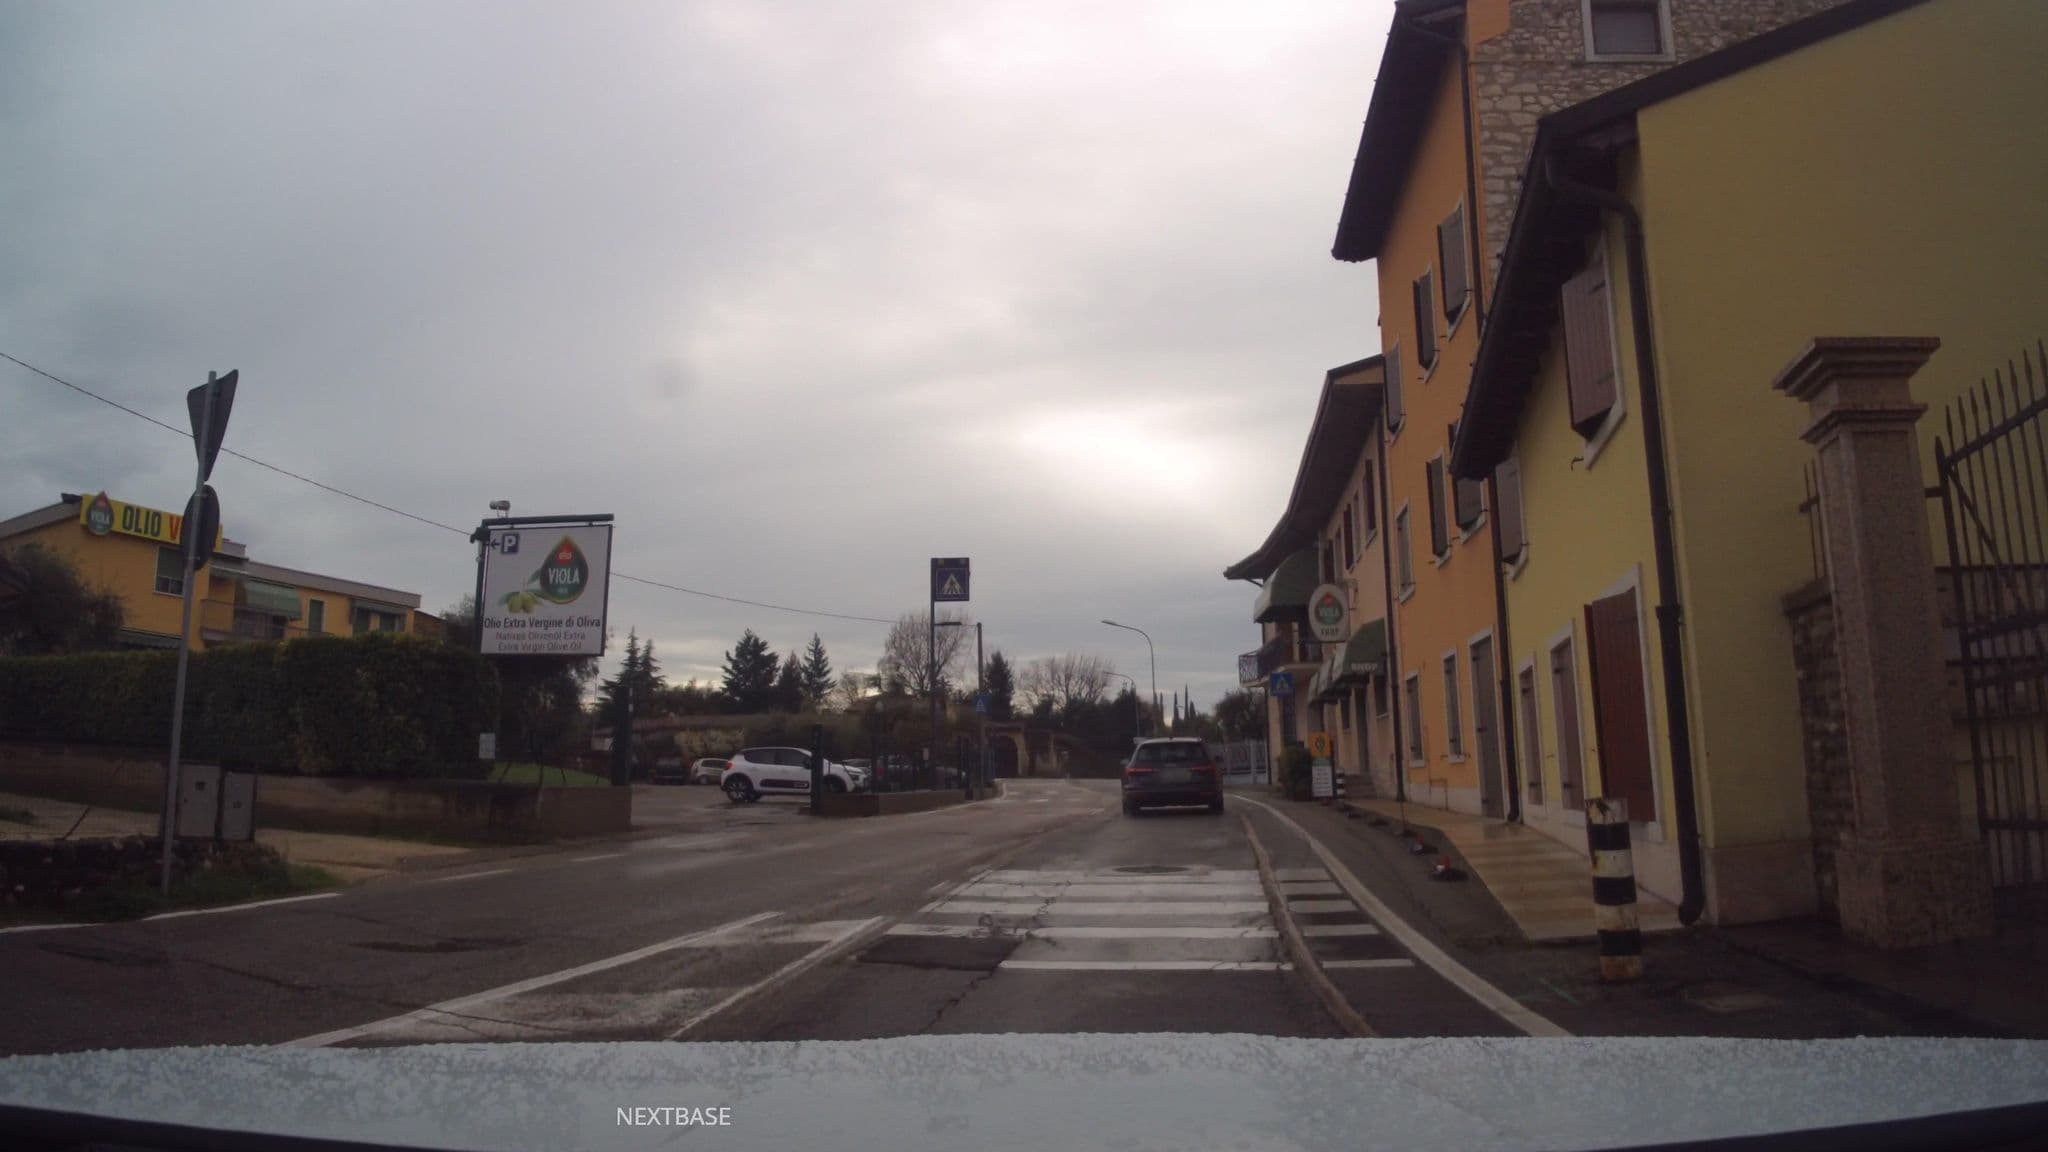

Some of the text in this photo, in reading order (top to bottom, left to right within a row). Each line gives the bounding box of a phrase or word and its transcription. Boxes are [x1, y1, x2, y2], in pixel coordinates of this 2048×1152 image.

[122, 505, 161, 537] OLIO
[503, 535, 517, 553] P
[548, 567, 580, 585] VIOLA
[484, 615, 601, 631] Olio Extra Vergine di Oliva
